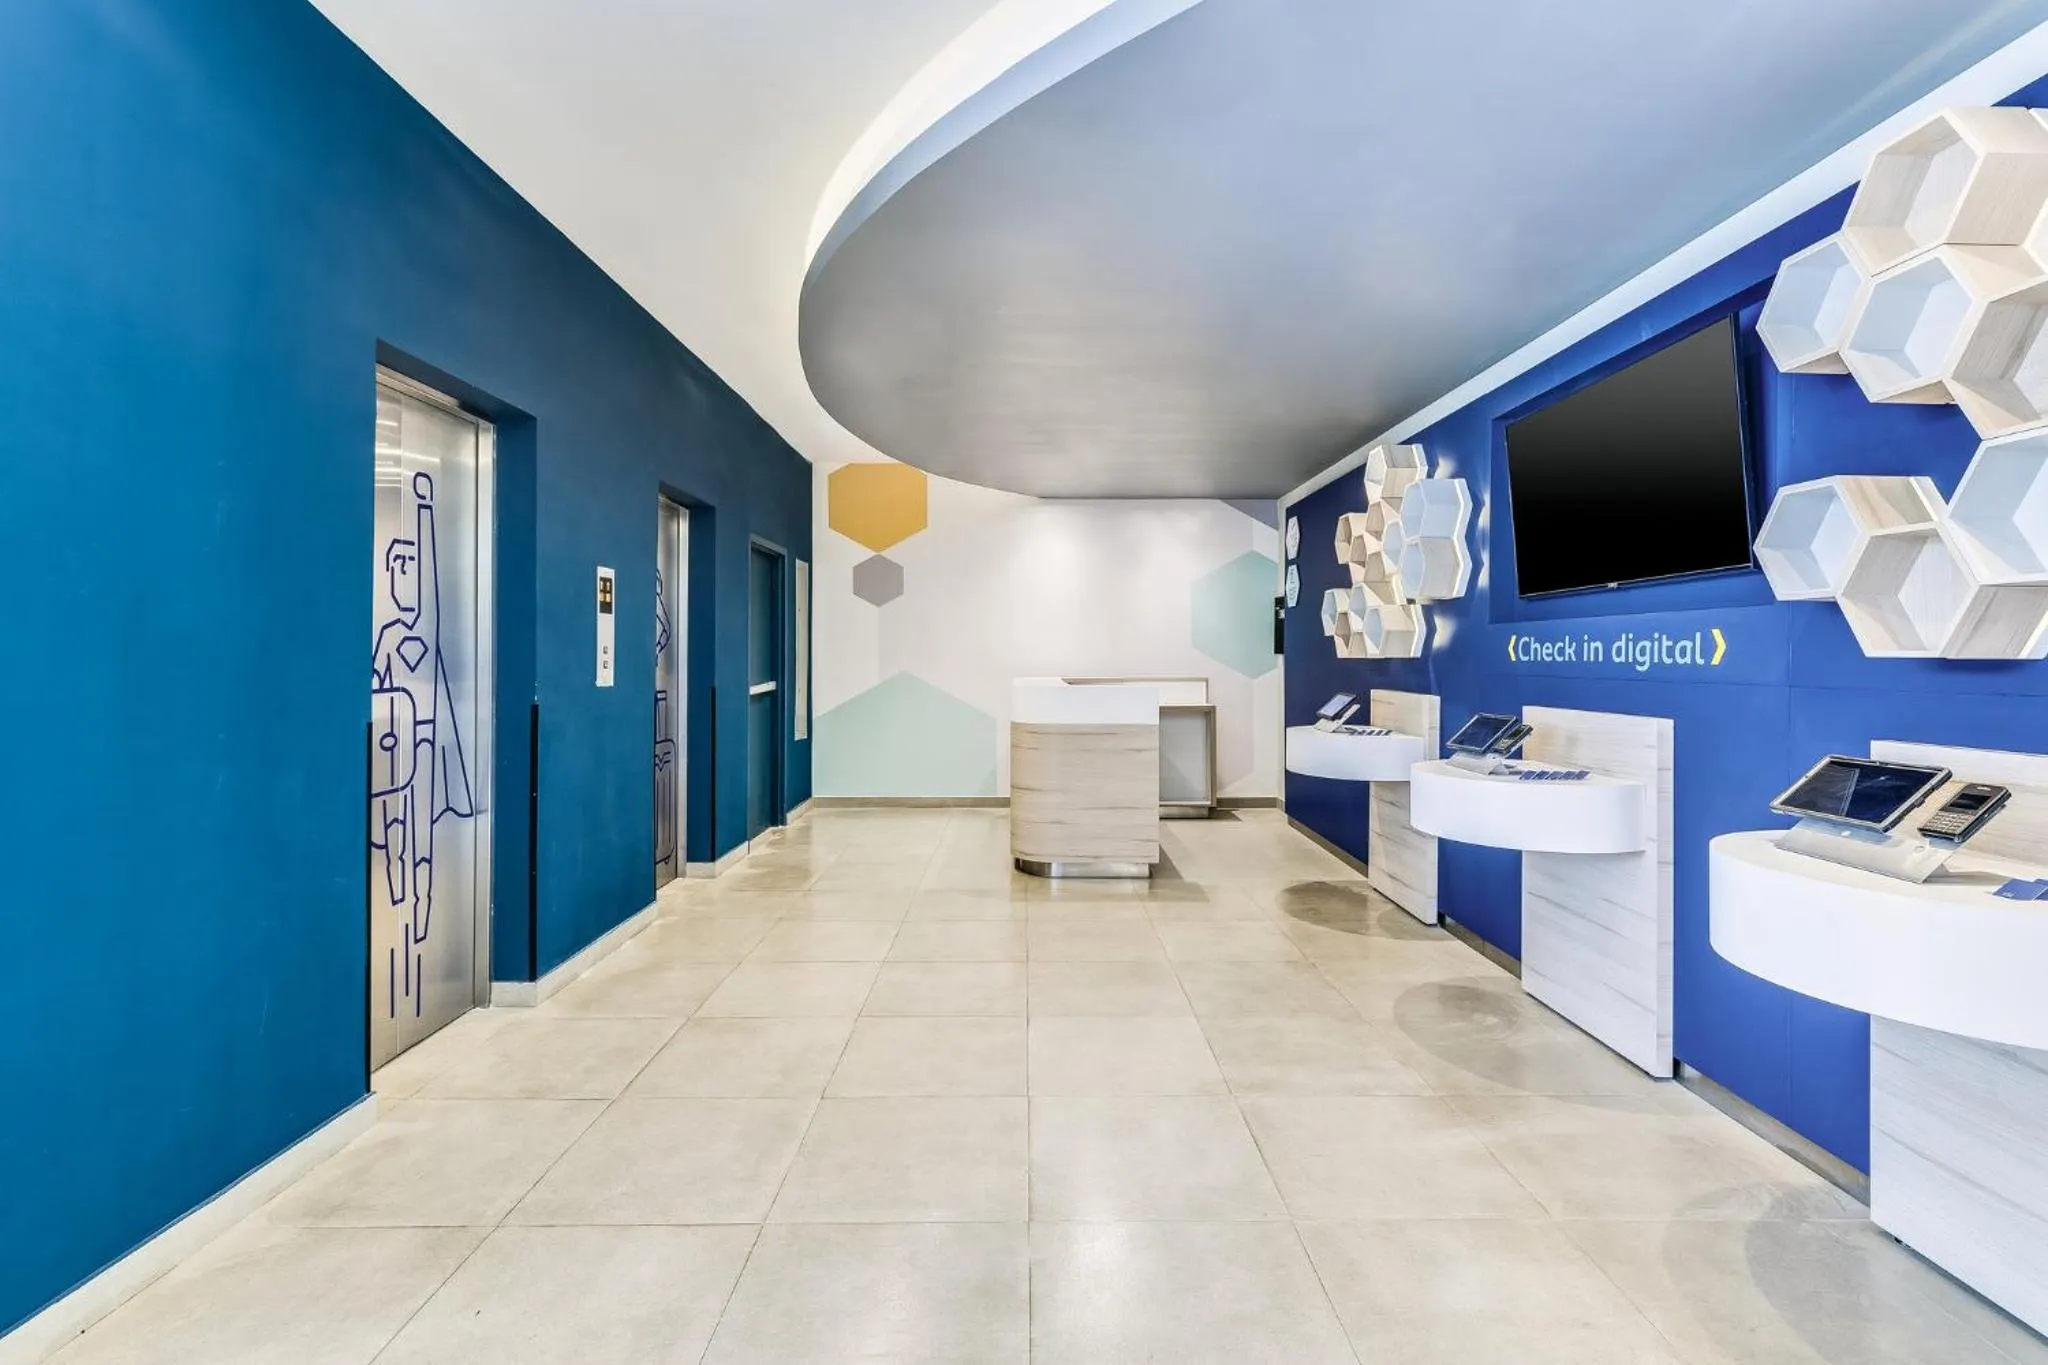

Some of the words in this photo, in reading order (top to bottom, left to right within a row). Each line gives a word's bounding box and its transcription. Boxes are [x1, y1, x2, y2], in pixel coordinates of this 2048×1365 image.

[1518, 635, 1576, 662] Check
[1583, 634, 1604, 662] in
[1611, 631, 1705, 671] digital
